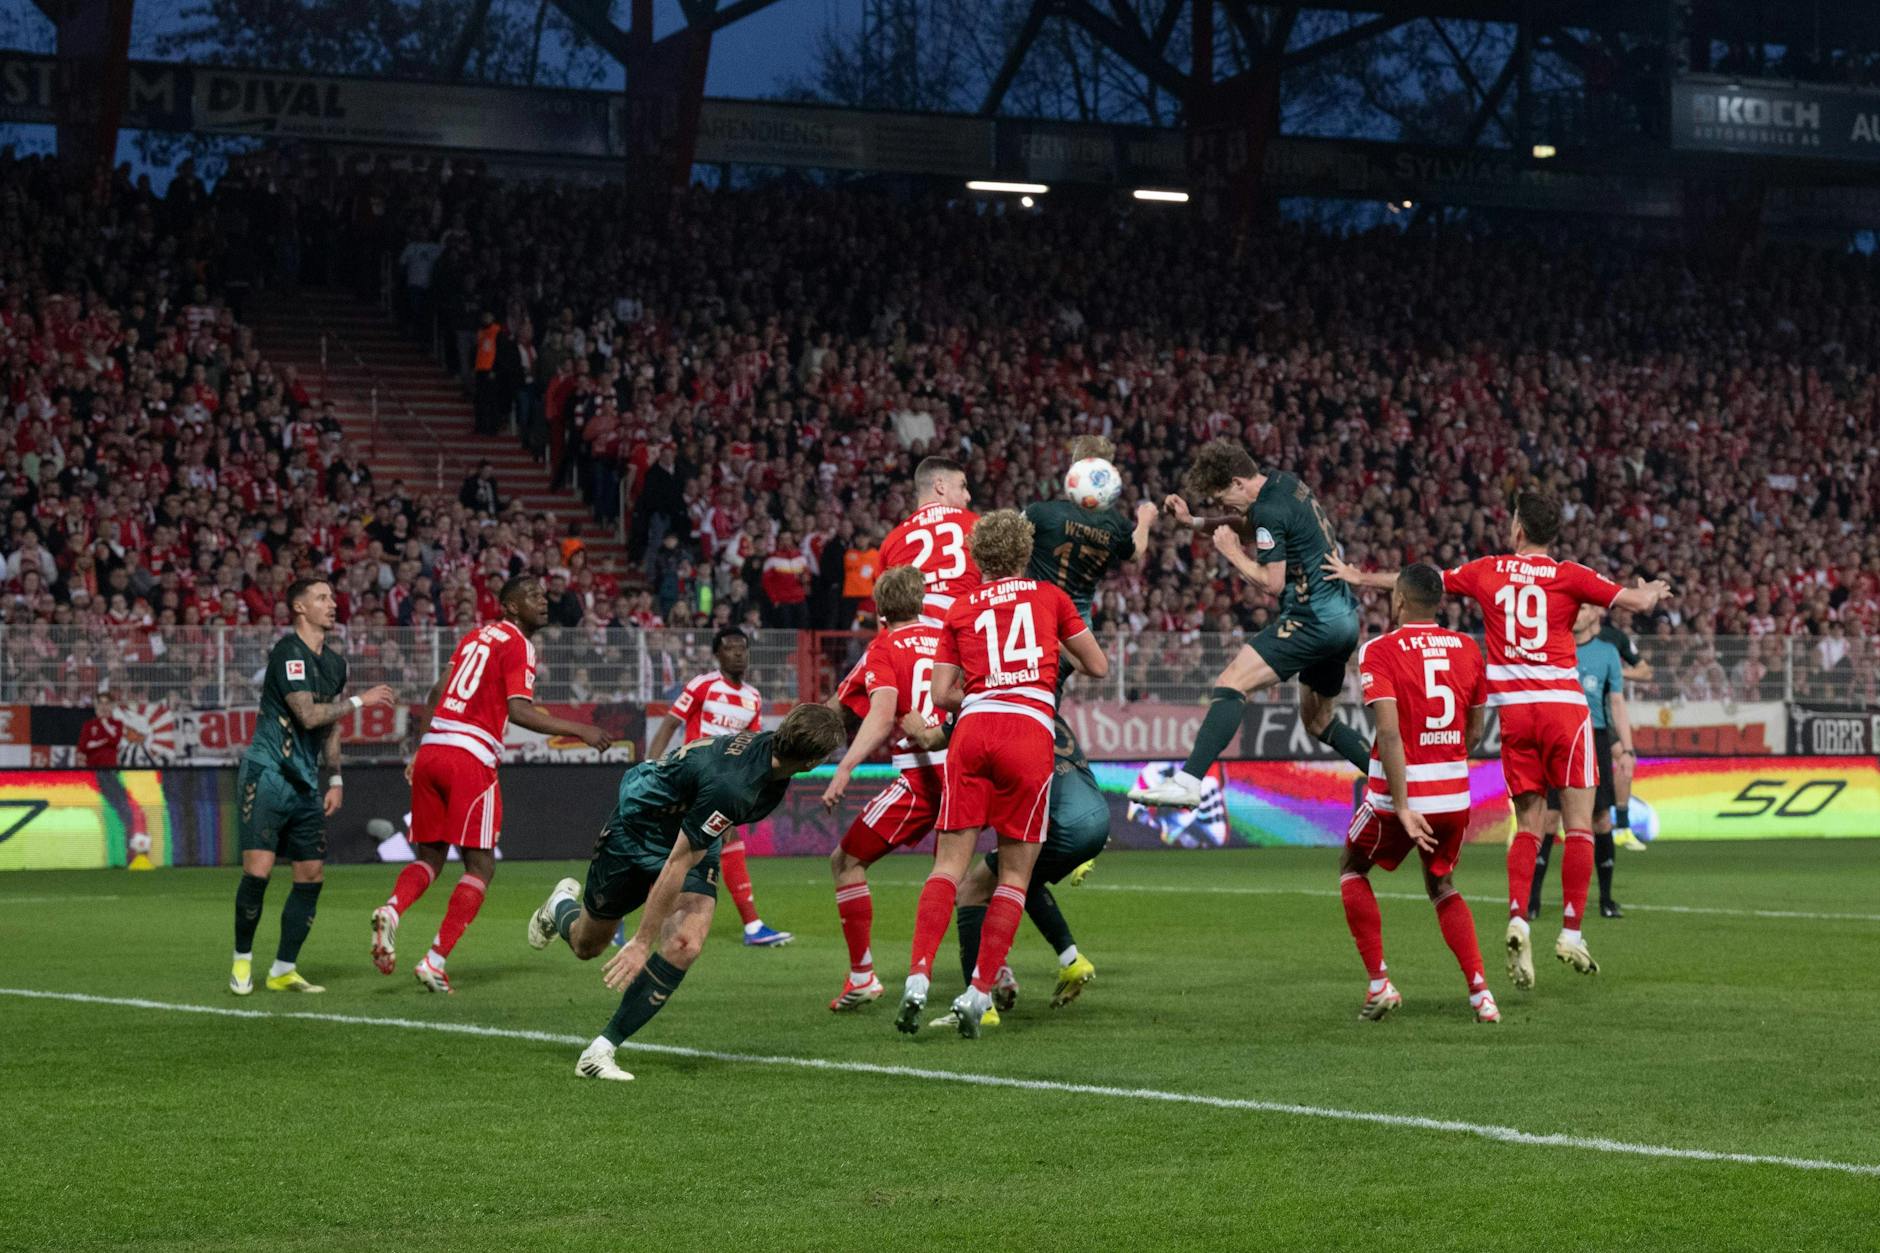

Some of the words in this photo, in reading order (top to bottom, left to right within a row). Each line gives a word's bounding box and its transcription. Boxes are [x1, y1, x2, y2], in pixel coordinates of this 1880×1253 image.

[206, 77, 346, 118] DIVAL
[1718, 95, 1820, 129] KOCH
[905, 522, 966, 585] 23
[1496, 560, 1504, 572] 1.
[1505, 560, 1519, 573] FC
[1520, 562, 1556, 578] UNION
[969, 594, 979, 605] 1.
[980, 587, 994, 601] FC
[997, 580, 1037, 595] UNION
[1509, 573, 1535, 585] BERLIN
[989, 592, 1017, 607] BERLIN
[1494, 584, 1548, 650] 19
[974, 602, 1044, 675] 14
[1398, 638, 1410, 652] 1.
[1410, 636, 1426, 649] FC
[1427, 636, 1463, 648] UNION
[1422, 648, 1447, 657] BERLIN
[447, 641, 491, 700] 10
[1424, 658, 1455, 729] 5
[1420, 730, 1460, 746] DOEKHI
[1812, 718, 1864, 754] OBER
[1715, 779, 1847, 818] 50
